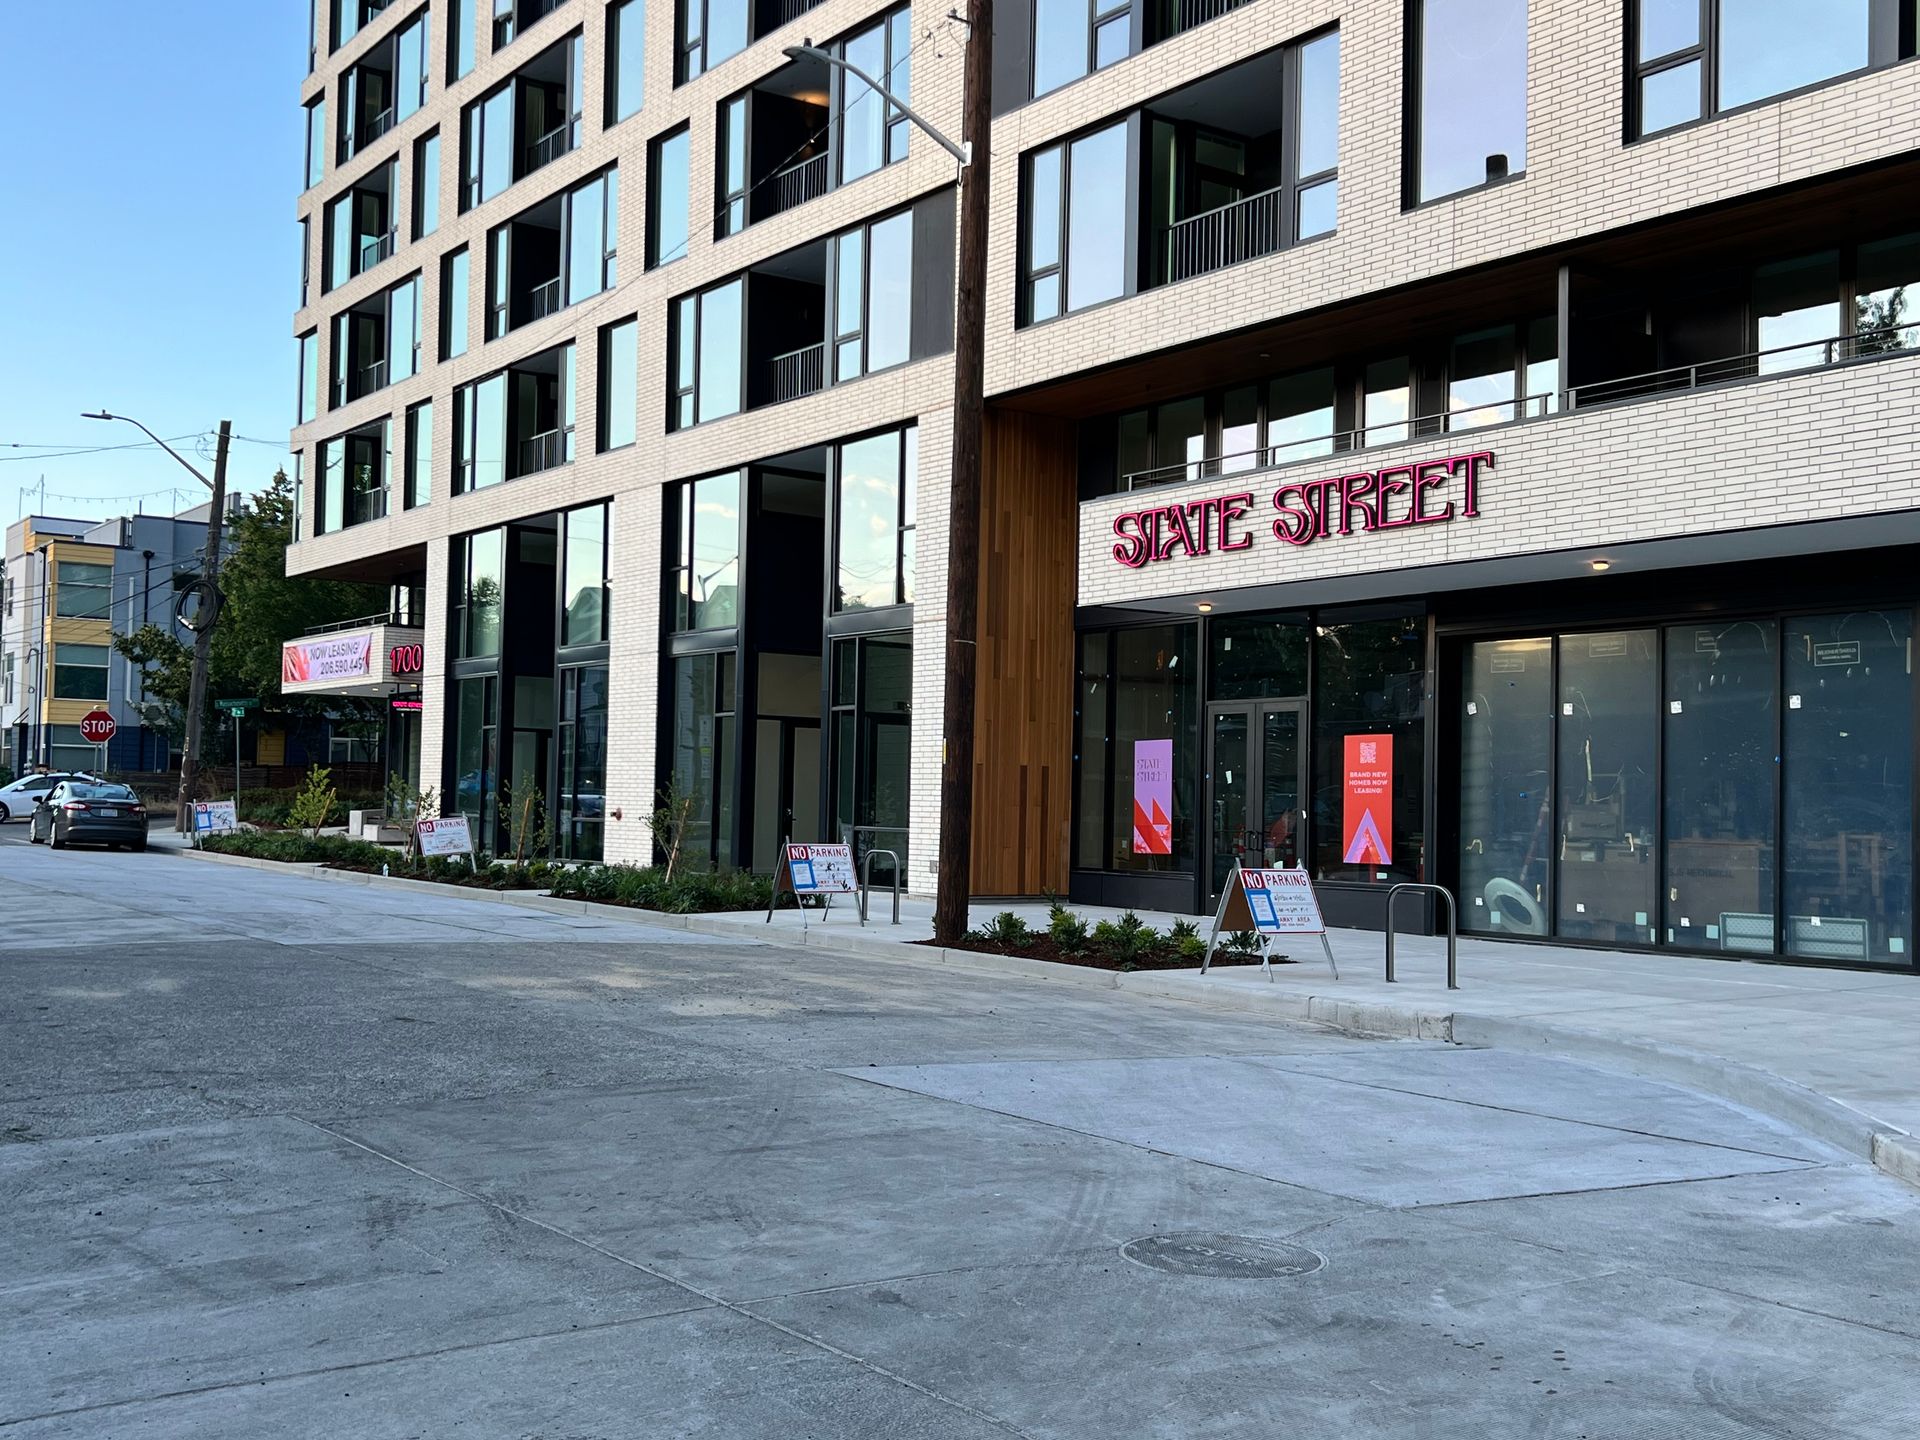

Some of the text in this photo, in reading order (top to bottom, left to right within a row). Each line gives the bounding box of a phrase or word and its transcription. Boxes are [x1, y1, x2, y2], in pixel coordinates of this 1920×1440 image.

[1113, 451, 1495, 568] STATE STREET
[310, 646, 327, 660] NOW
[390, 644, 423, 674] 1700
[82, 720, 114, 733] STOP
[1137, 758, 1160, 769] STATE
[1137, 771, 1168, 782] STREET
[196, 804, 207, 813] NO
[419, 819, 466, 832] NO PARKING
[792, 847, 848, 859] NO PARKING
[1245, 873, 1306, 888] NO PARKING
